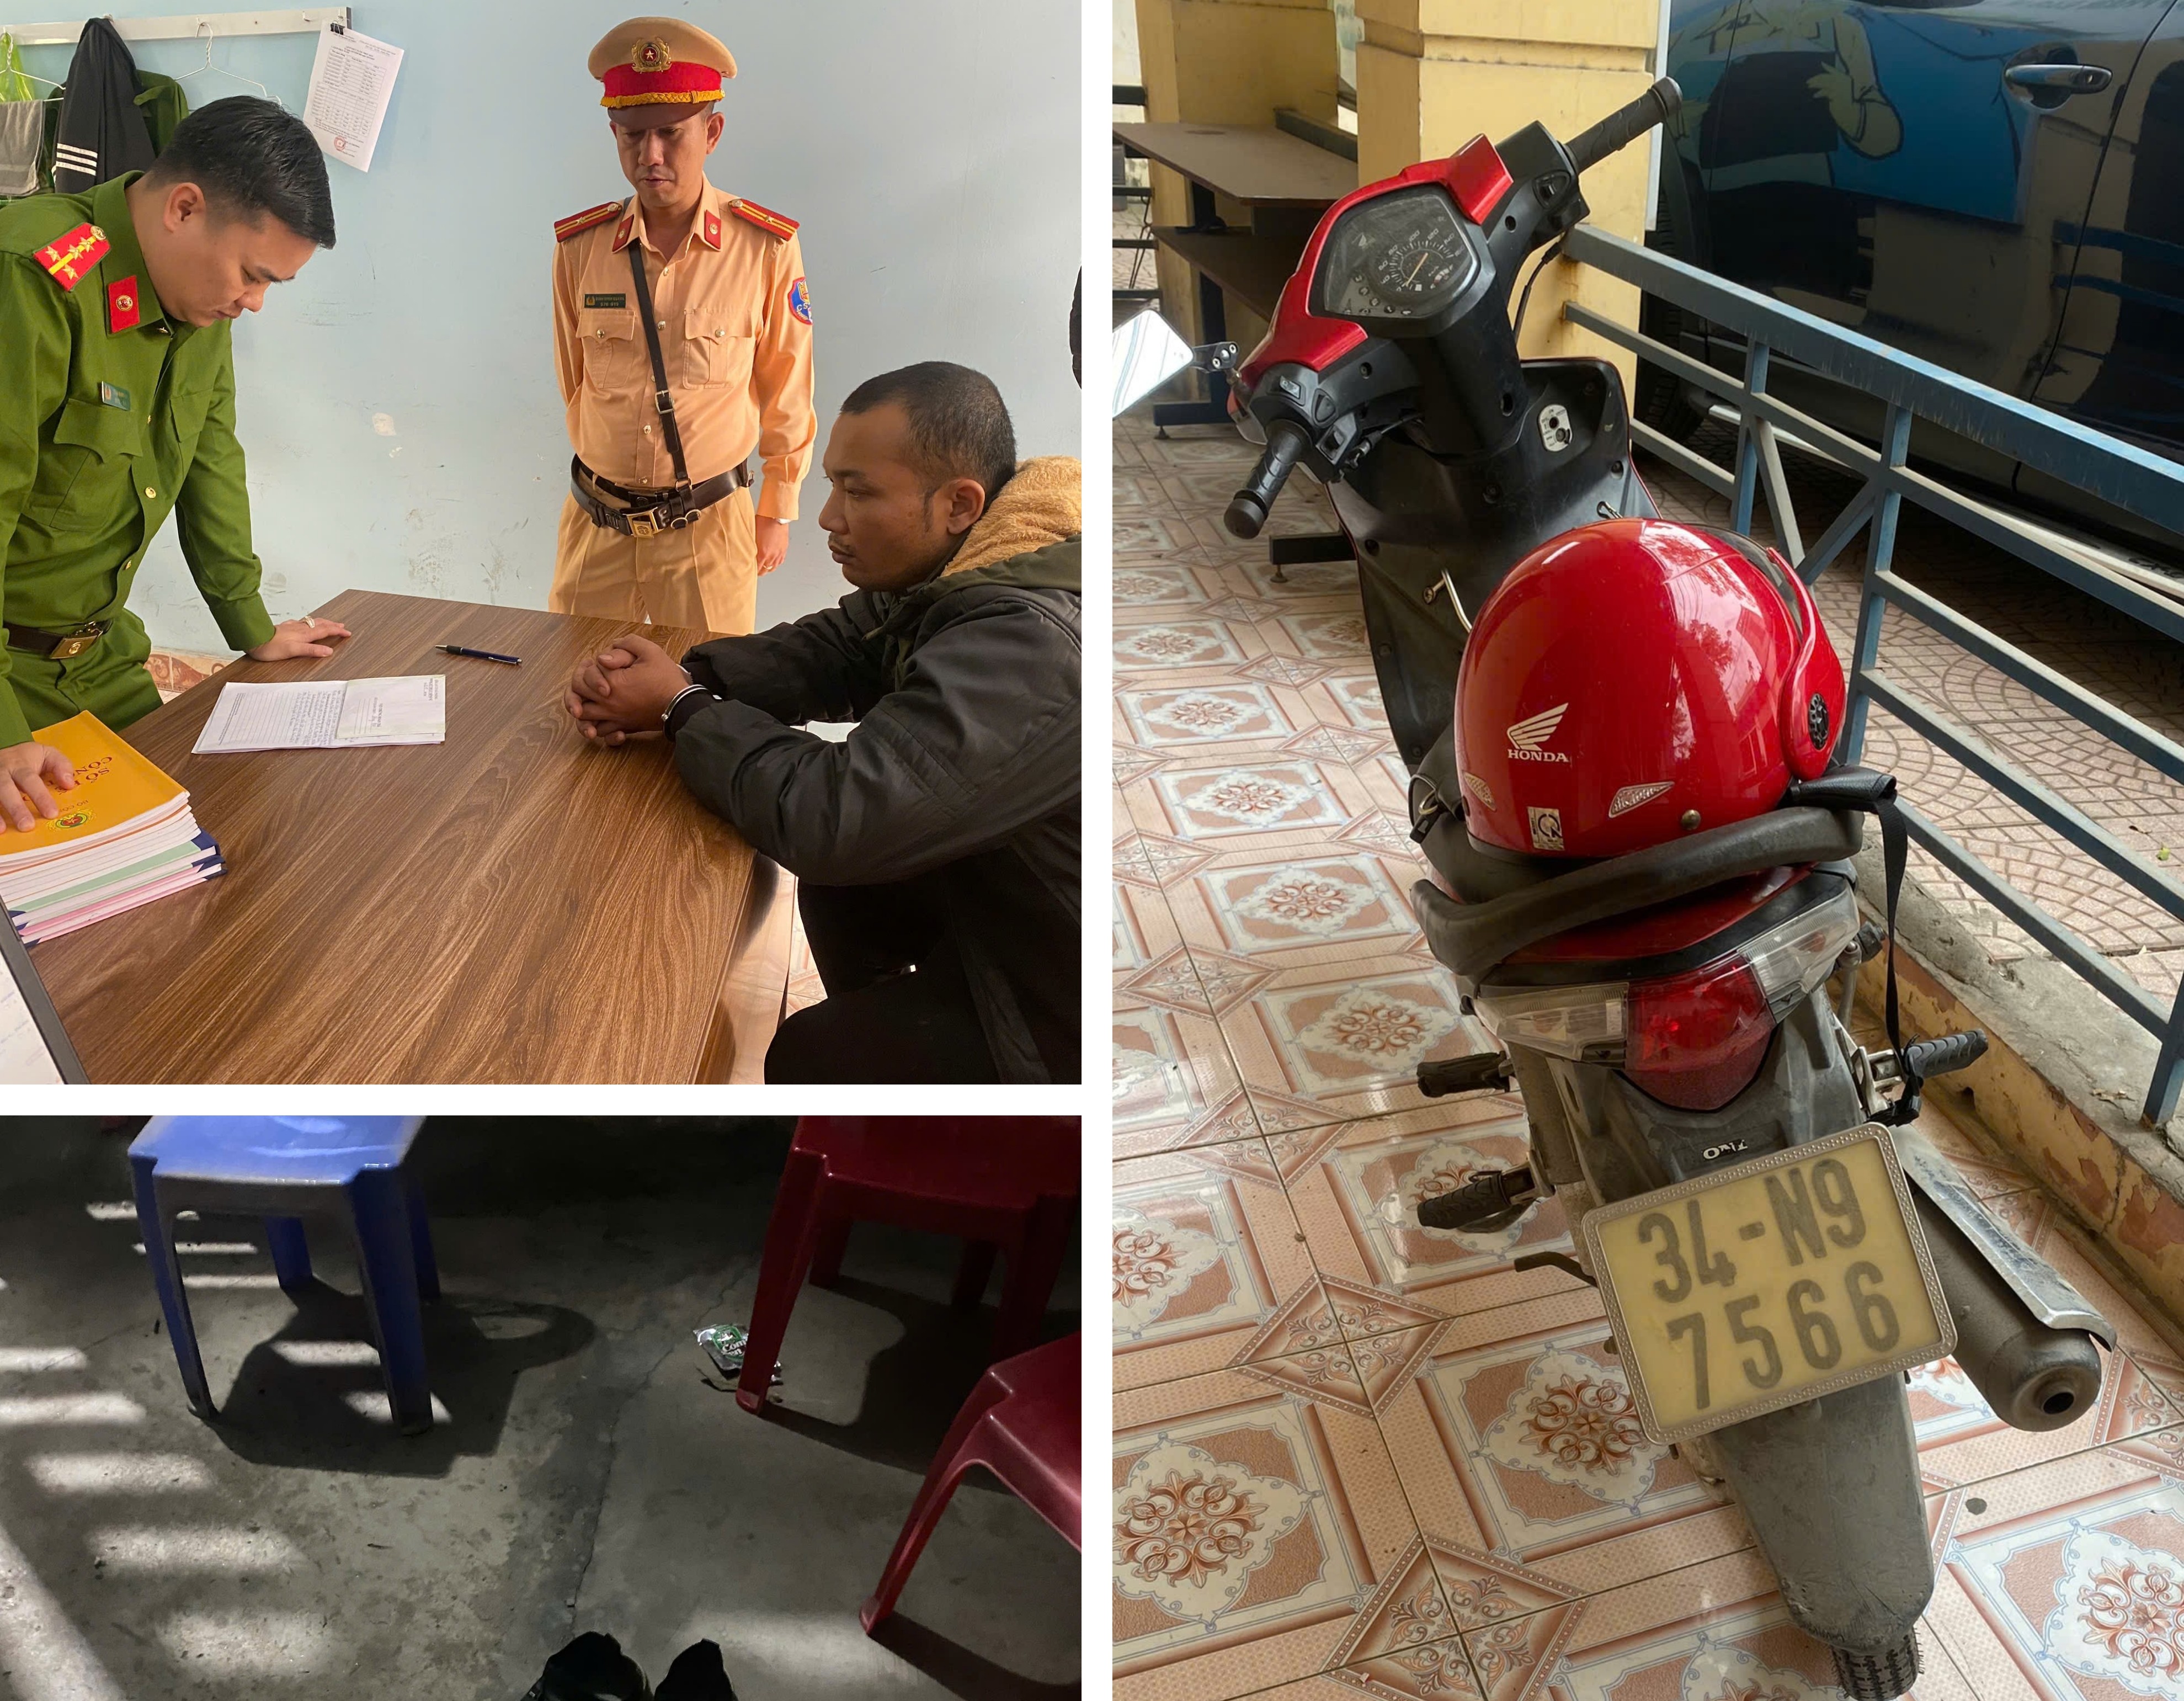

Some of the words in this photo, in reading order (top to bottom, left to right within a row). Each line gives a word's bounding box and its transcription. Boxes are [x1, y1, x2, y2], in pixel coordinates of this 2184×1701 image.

[73, 756, 113, 777] CÔN
[1508, 749, 1569, 763] HONDA
[1638, 1158, 1866, 1303] 34-N9
[1666, 1261, 1900, 1410] 7566
